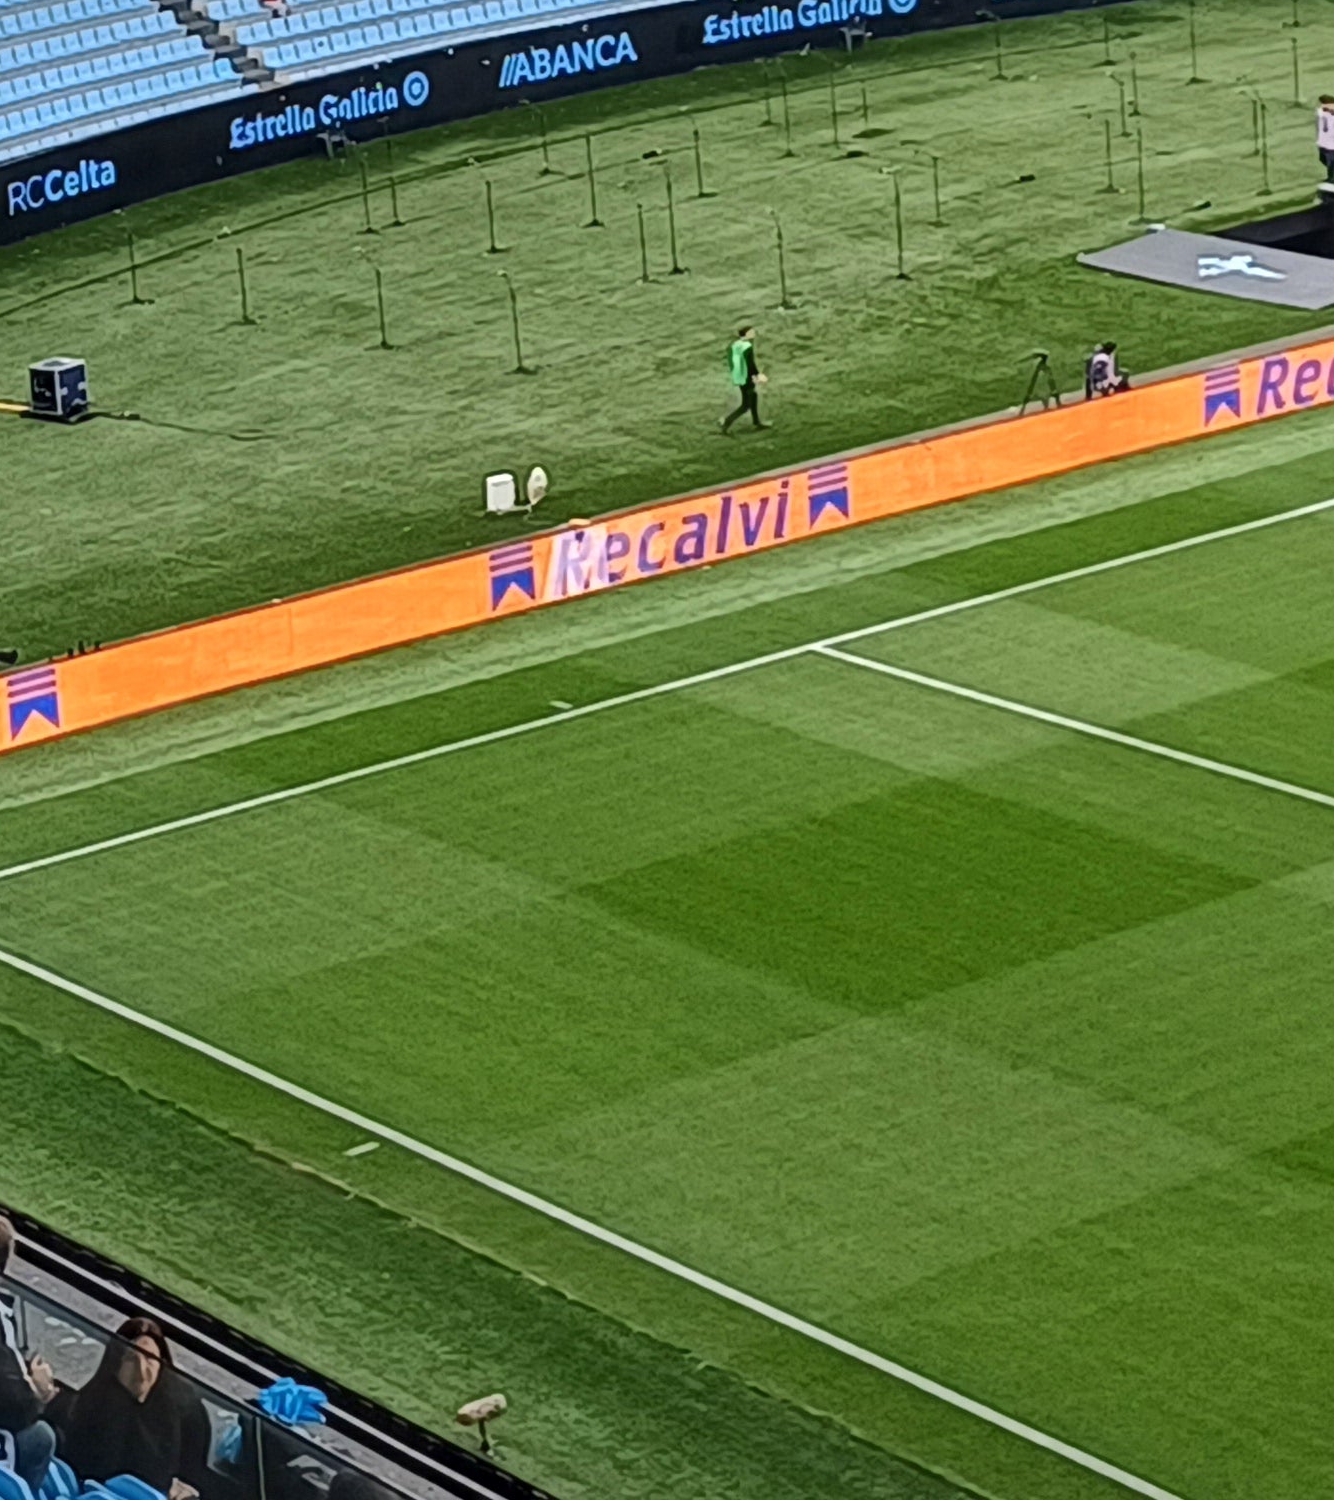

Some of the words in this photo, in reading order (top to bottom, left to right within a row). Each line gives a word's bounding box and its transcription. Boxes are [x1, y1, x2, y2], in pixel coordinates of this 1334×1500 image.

[702, 5, 795, 44] Estrella
[498, 31, 638, 88] ABANCA
[229, 104, 316, 150] Estrella
[318, 83, 399, 126] Galicia
[7, 159, 116, 217] RCCelta
[556, 480, 789, 599] Recalvi
